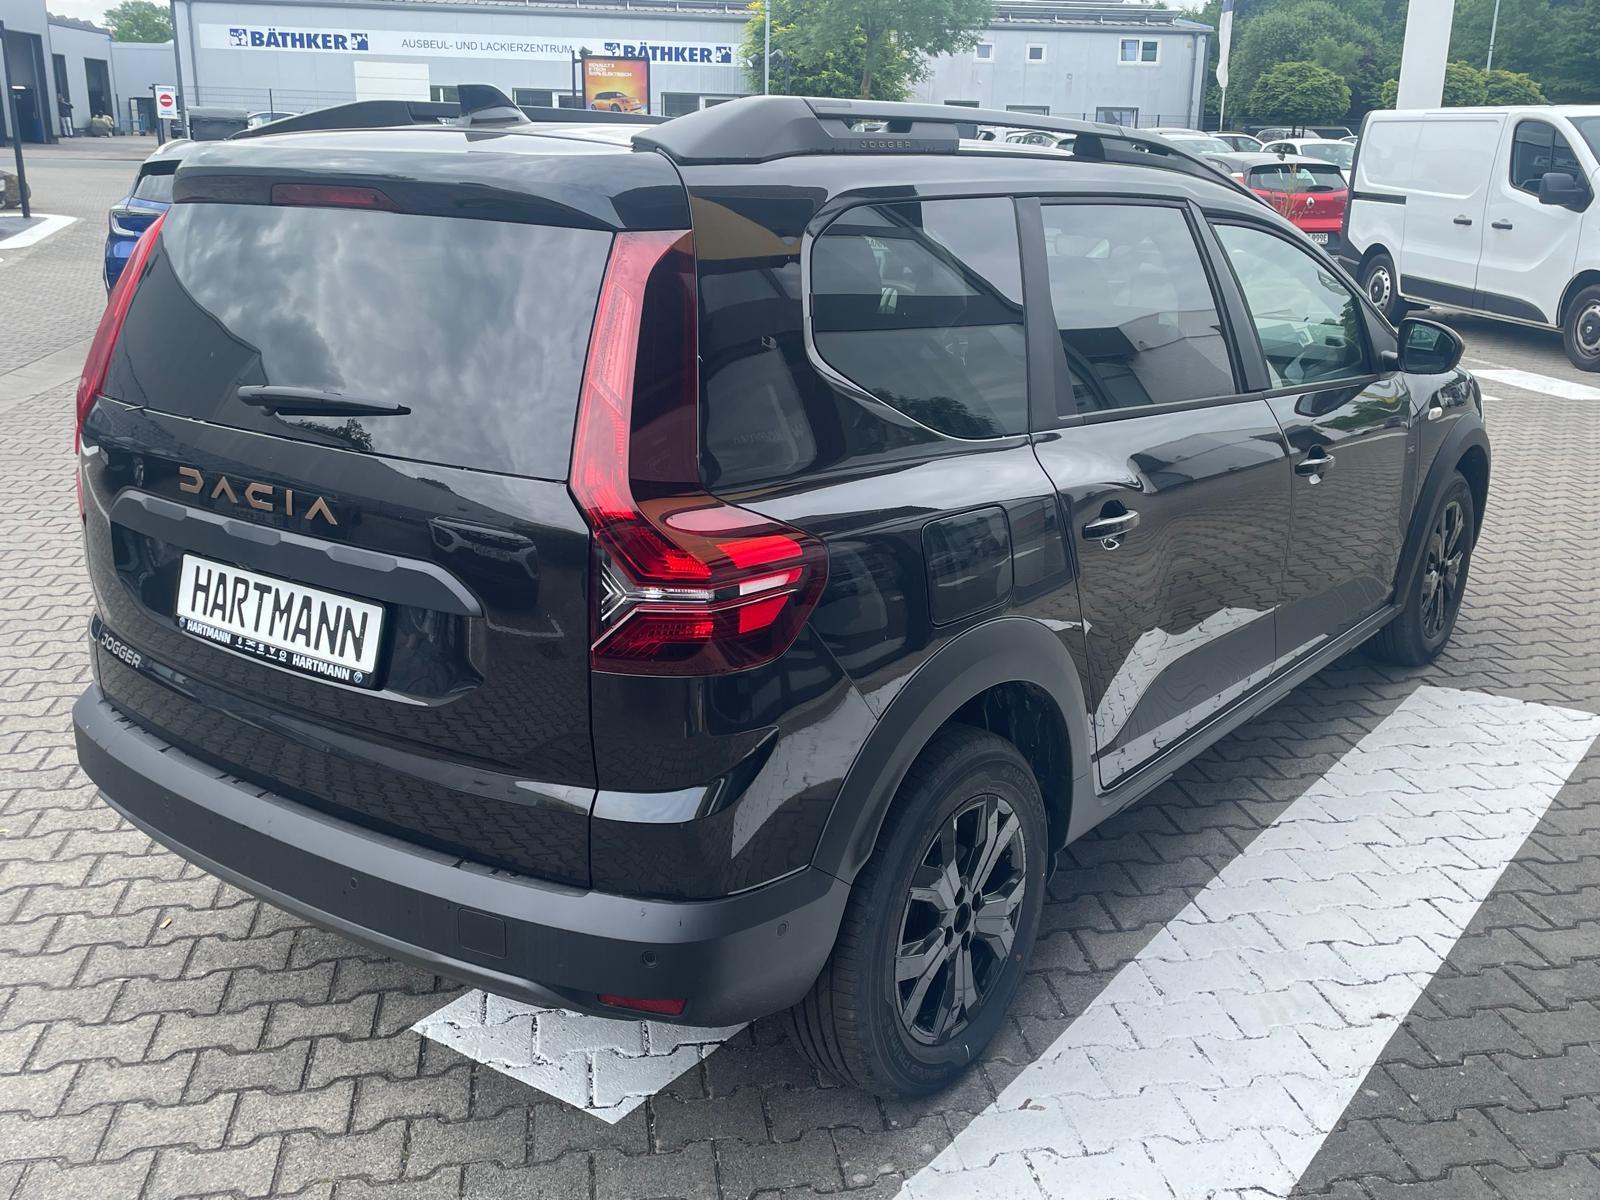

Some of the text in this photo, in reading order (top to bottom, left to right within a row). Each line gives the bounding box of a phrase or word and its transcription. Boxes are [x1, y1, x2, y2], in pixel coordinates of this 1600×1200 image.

[250, 28, 348, 50] BÄTHKER
[401, 39, 573, 54] AUSBEUL- UND LACKIERZENTRUM
[623, 42, 713, 63] BÄTHKER
[861, 140, 911, 148] JOGGER
[179, 466, 338, 525] DACIA
[190, 565, 369, 662] HARTMANN
[186, 619, 232, 644] HARTMANN
[101, 633, 142, 669] JOGGER
[291, 654, 350, 681] HARTMANN
